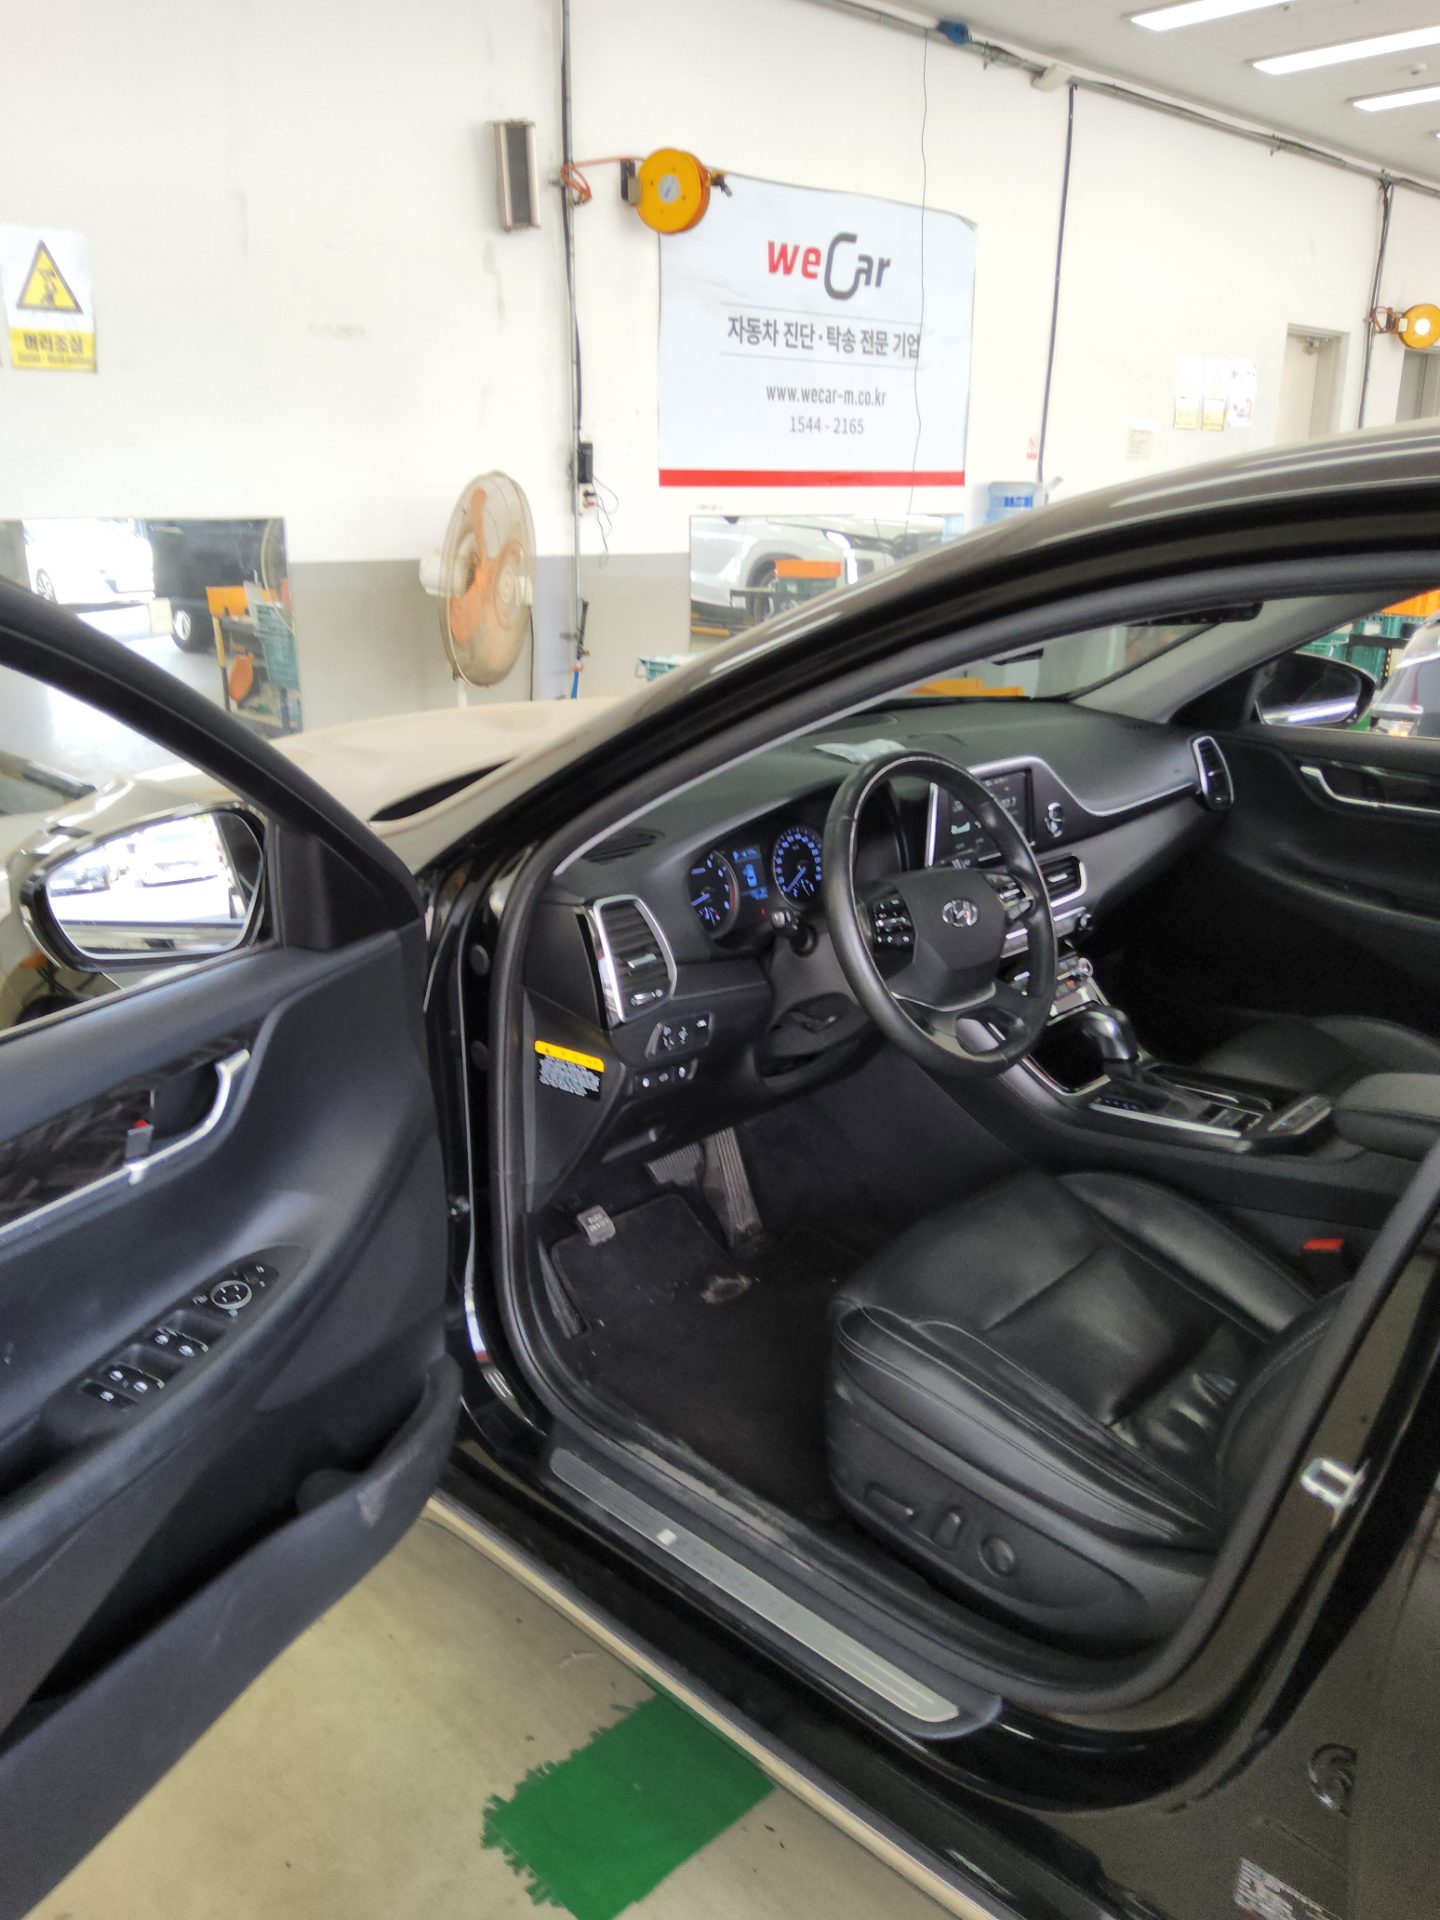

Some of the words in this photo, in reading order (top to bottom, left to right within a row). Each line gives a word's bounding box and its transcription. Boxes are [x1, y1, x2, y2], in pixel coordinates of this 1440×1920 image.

[727, 315, 780, 348] 자동차
[859, 329, 889, 357] 전문
[892, 332, 920, 360] 기업
[765, 385, 887, 407] www.wecar-m.co.kr
